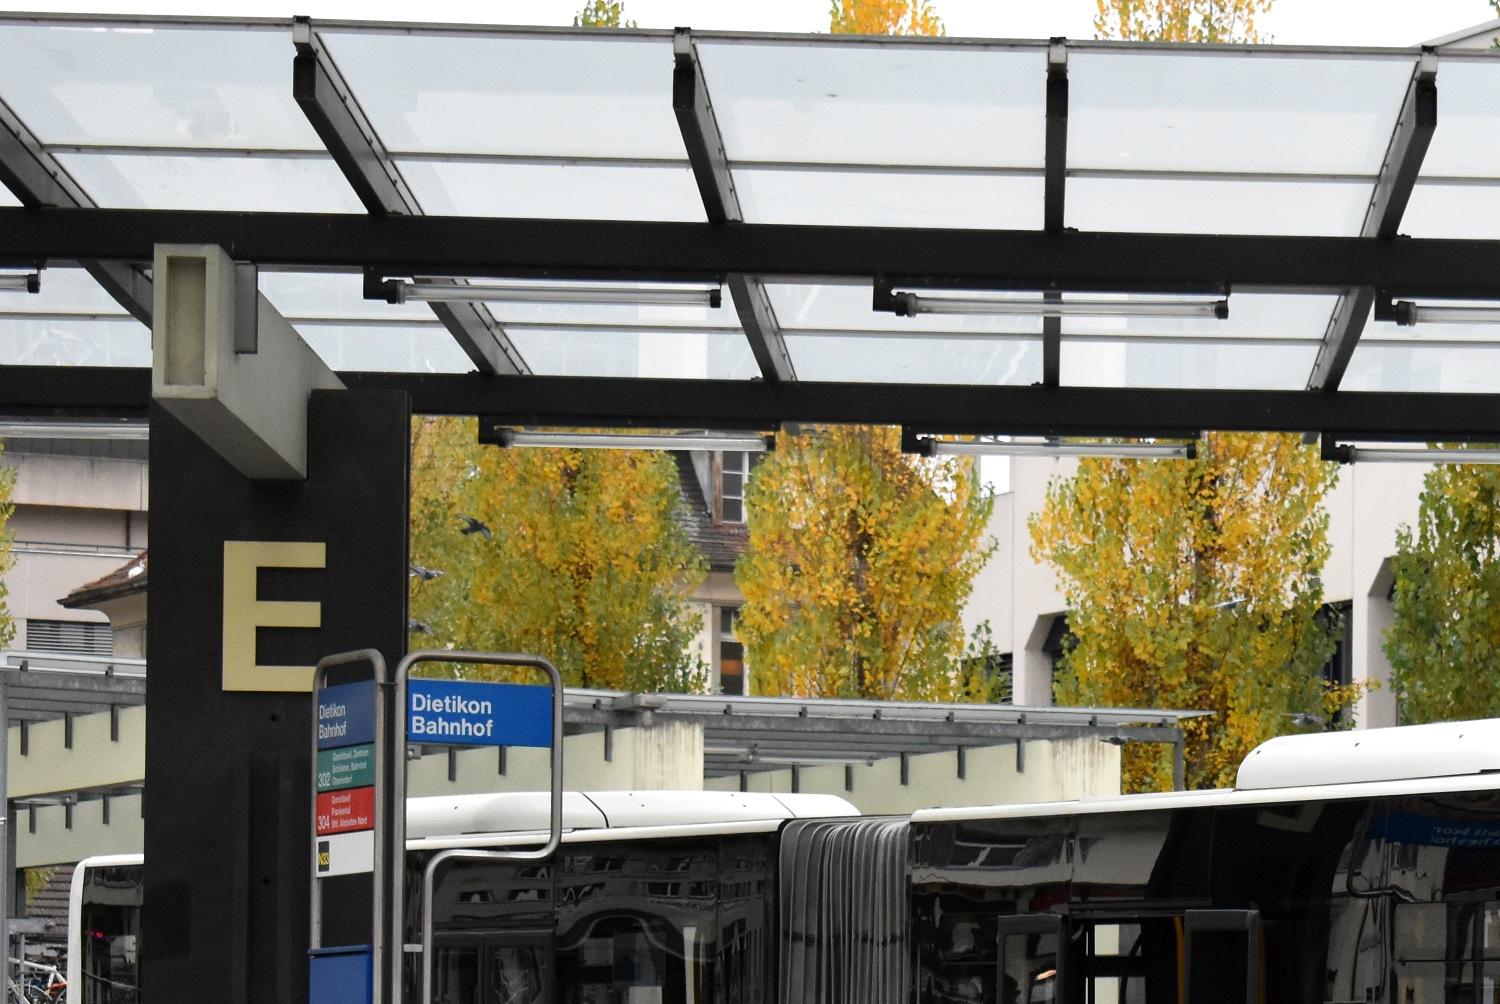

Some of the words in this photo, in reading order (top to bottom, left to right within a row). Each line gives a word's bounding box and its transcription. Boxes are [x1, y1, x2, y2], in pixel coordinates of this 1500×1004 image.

[222, 541, 327, 692] E
[319, 703, 346, 720] Dietikon
[412, 693, 492, 715] Dietikon
[318, 720, 347, 740] Bahnhof
[412, 716, 494, 737] Bahnhof
[318, 772, 331, 788] 302
[317, 815, 330, 831] 304
